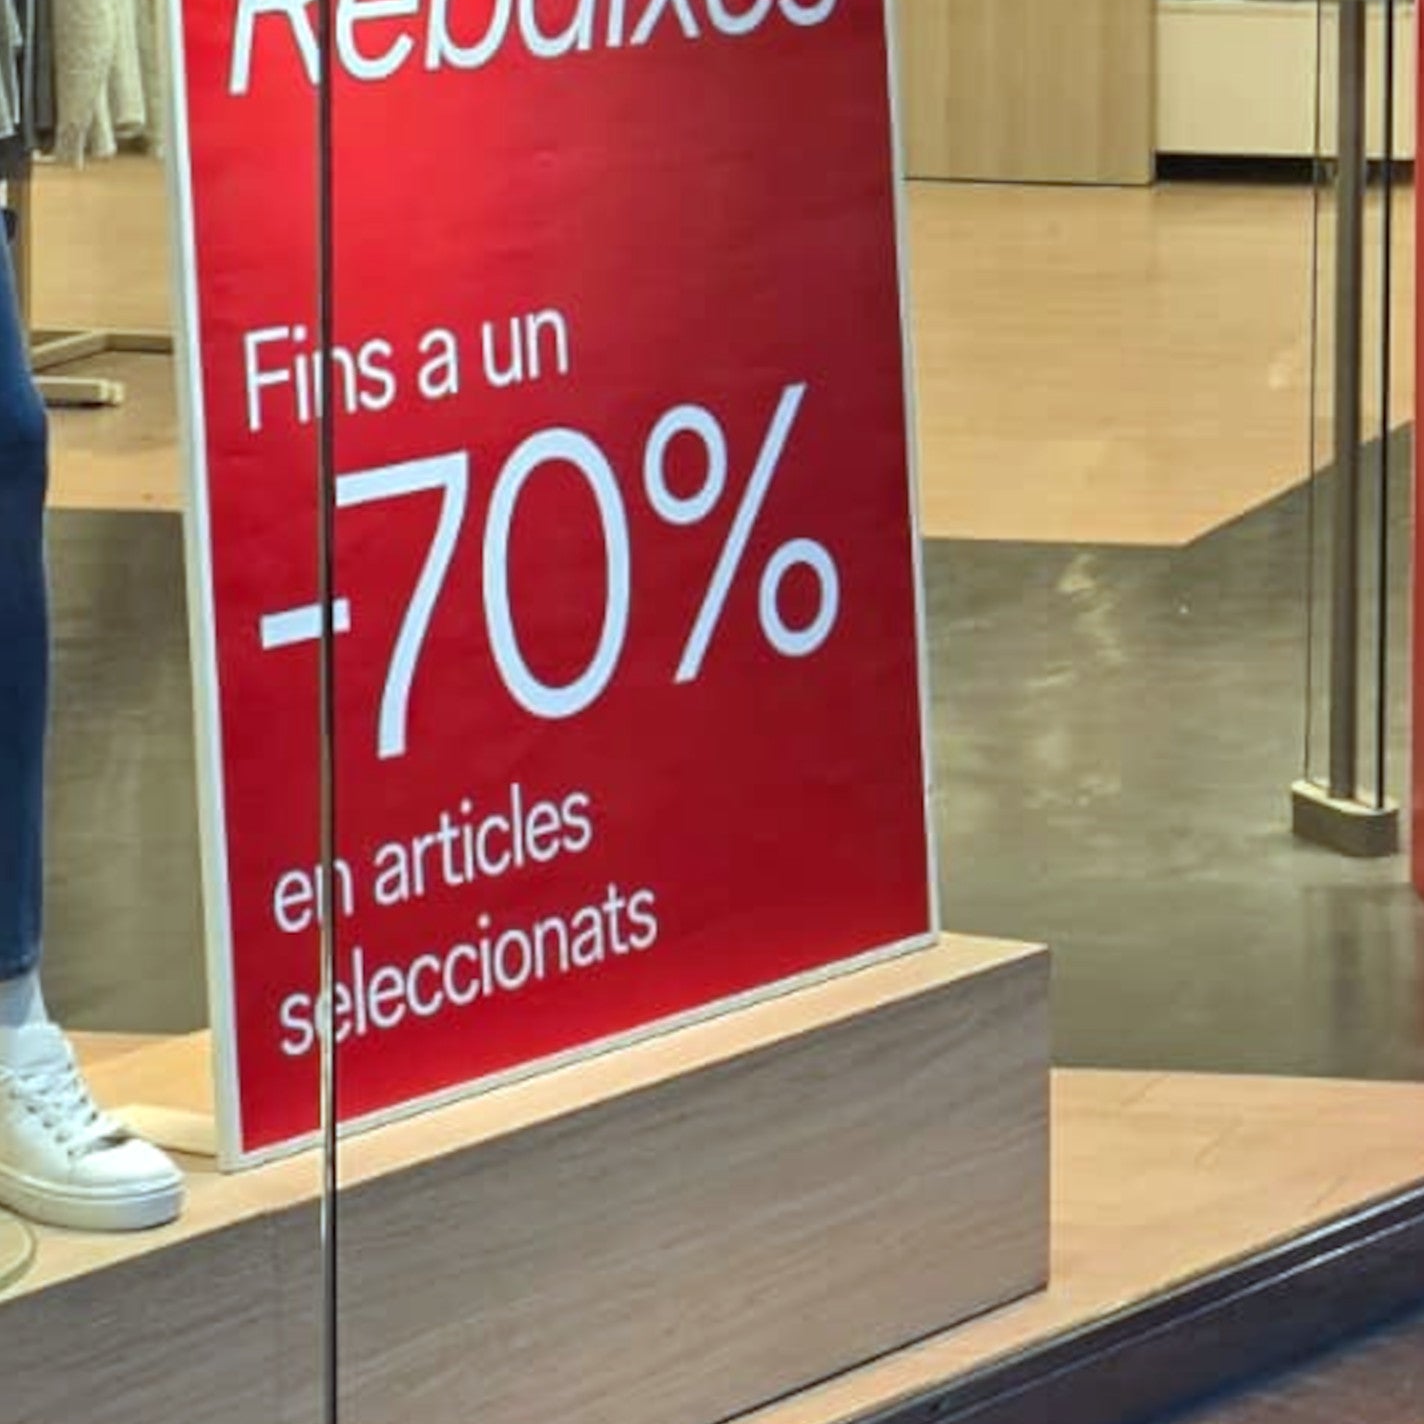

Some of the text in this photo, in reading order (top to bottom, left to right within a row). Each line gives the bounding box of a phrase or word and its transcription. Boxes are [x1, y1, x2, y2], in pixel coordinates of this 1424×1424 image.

[243, 308, 569, 432] Fins a un
[259, 381, 840, 760] -70%
[273, 782, 593, 933] en articles
[278, 883, 660, 1056] seleccionats
